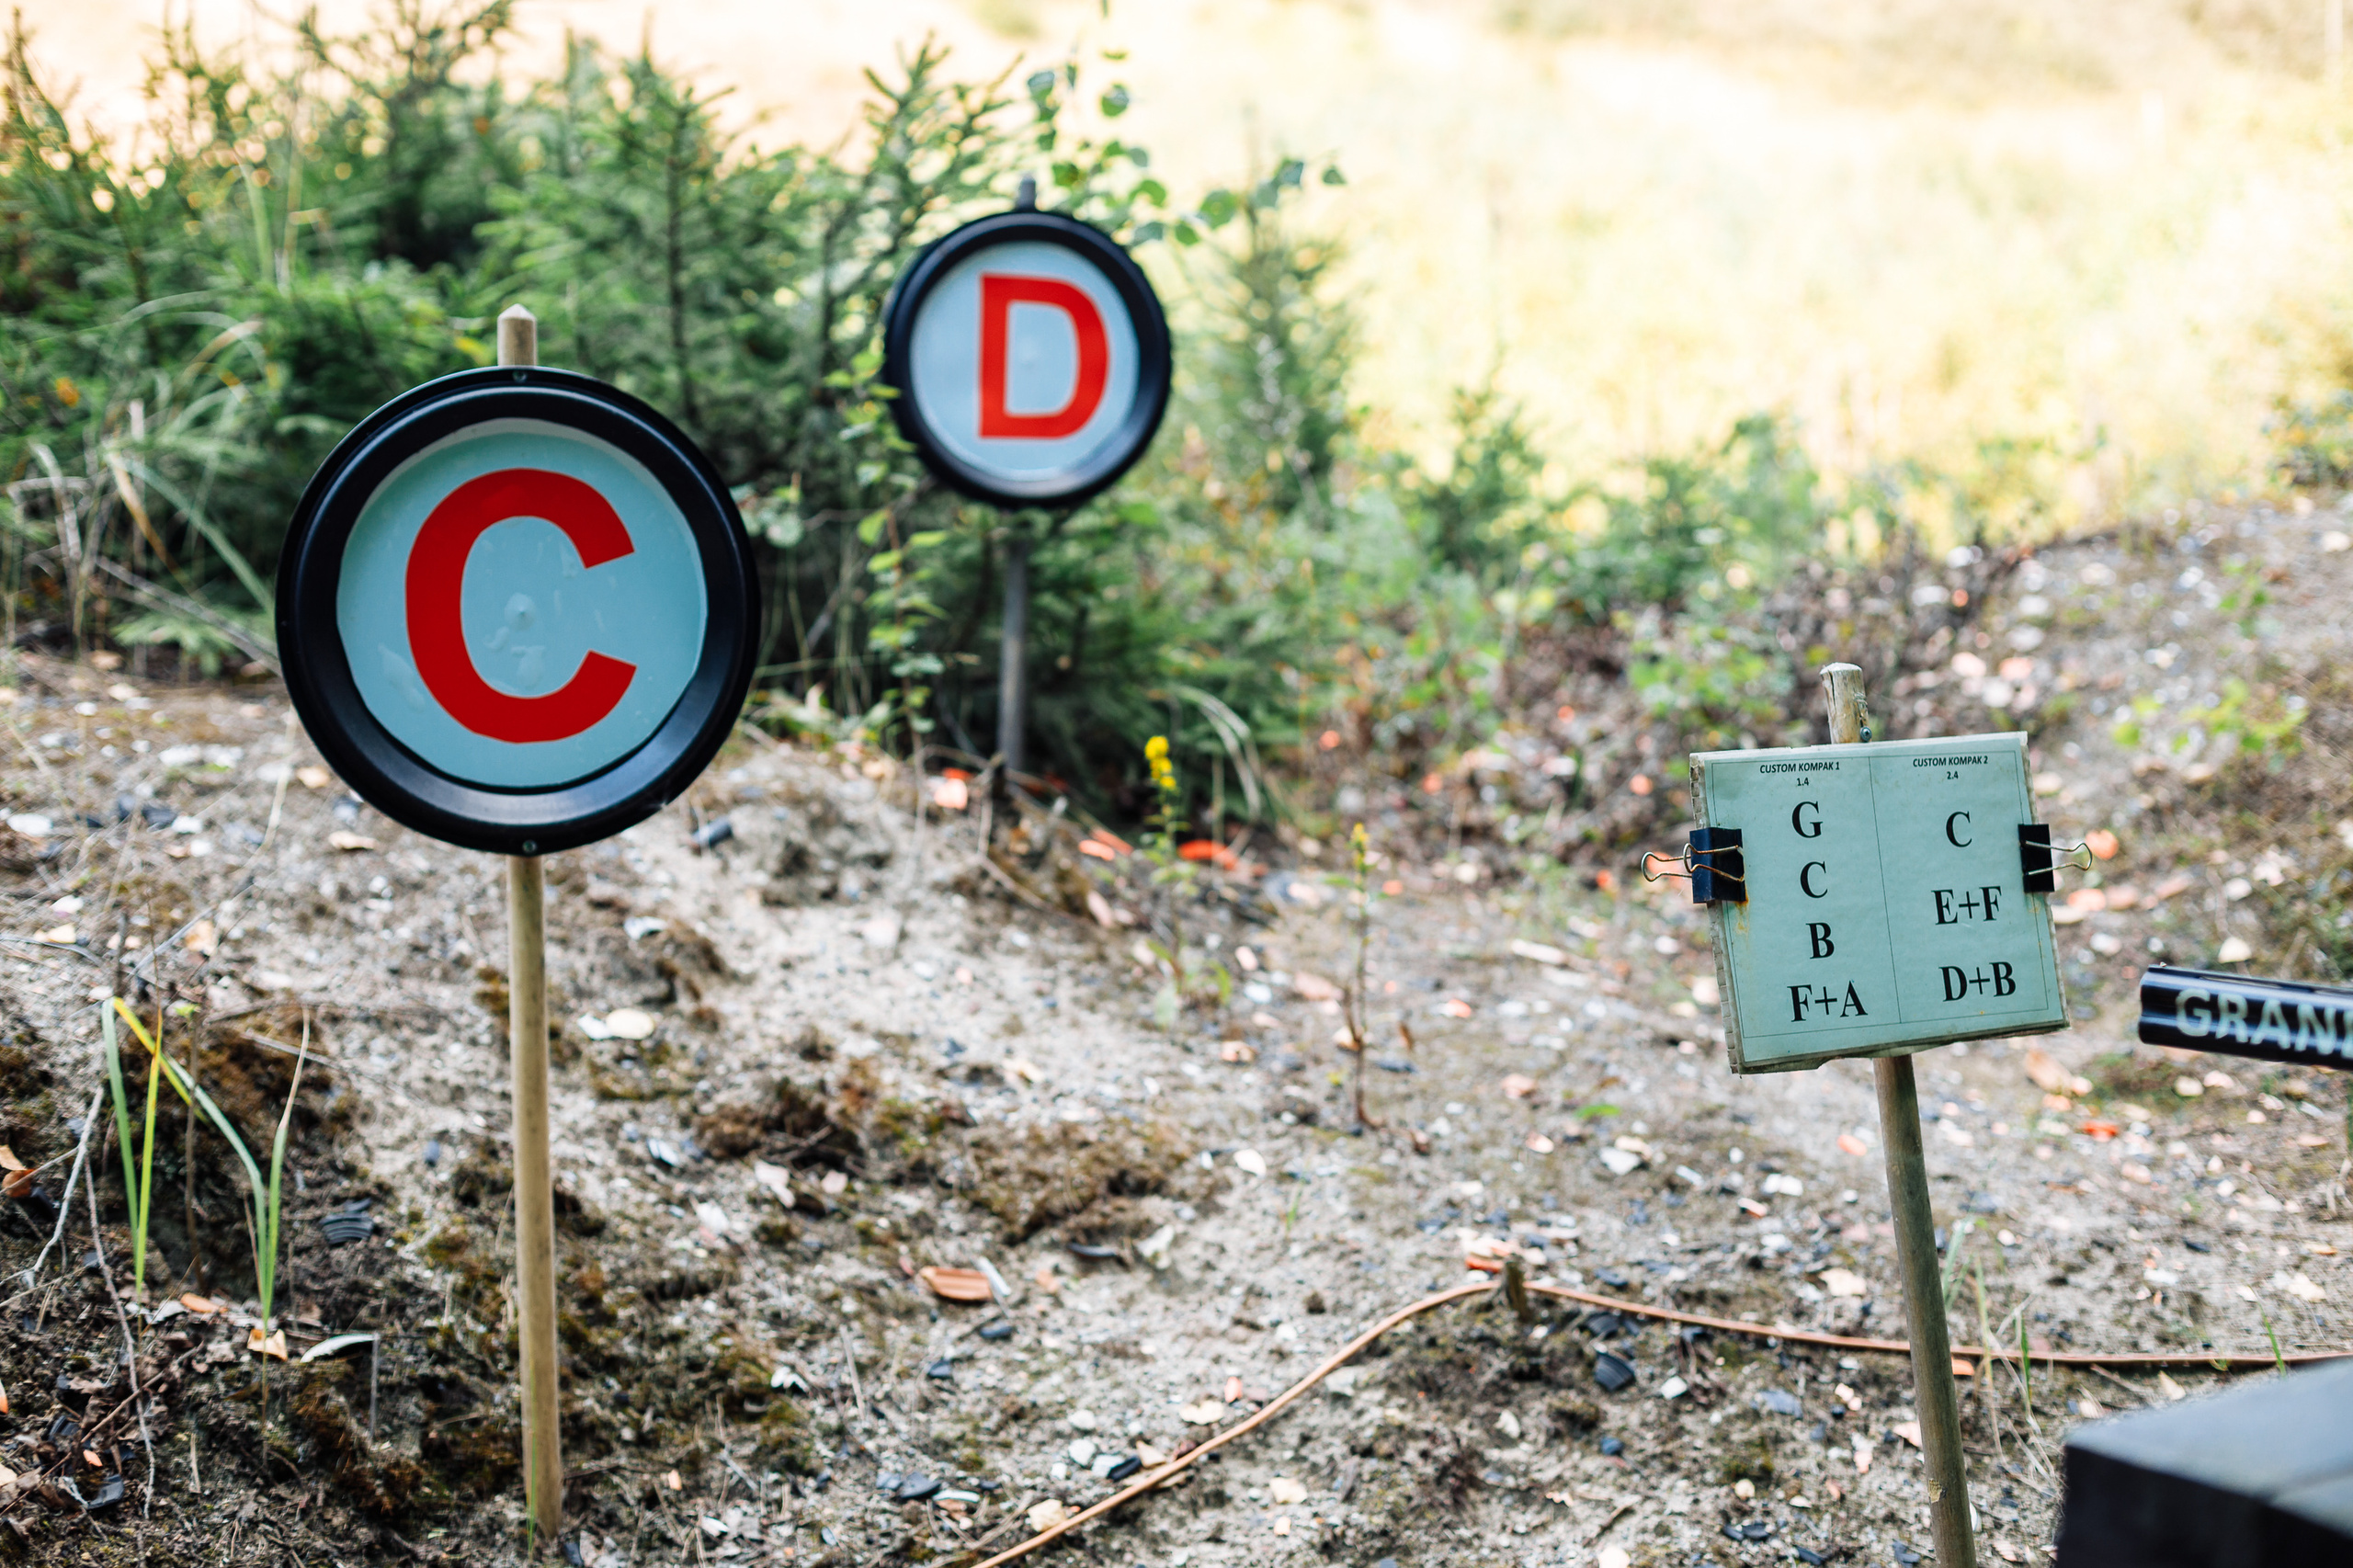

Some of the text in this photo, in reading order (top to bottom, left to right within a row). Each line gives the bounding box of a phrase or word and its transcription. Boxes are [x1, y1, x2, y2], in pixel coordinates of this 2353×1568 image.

[979, 274, 1110, 440] D
[405, 468, 637, 744] C
[1759, 761, 1840, 774] CUSTOM KOMPAK 1
[1913, 756, 1988, 767] CUSTOM KOMPAK 2
[1946, 770, 1959, 780] 2.4
[1796, 777, 1810, 787] 1.4
[1791, 801, 1824, 839] G
[1945, 811, 1972, 848] C
[1800, 860, 1828, 899] C
[1931, 885, 2002, 926] E+F
[1805, 922, 1835, 960] B
[1938, 961, 2017, 1002] D+B
[1787, 980, 1869, 1023] F+A
